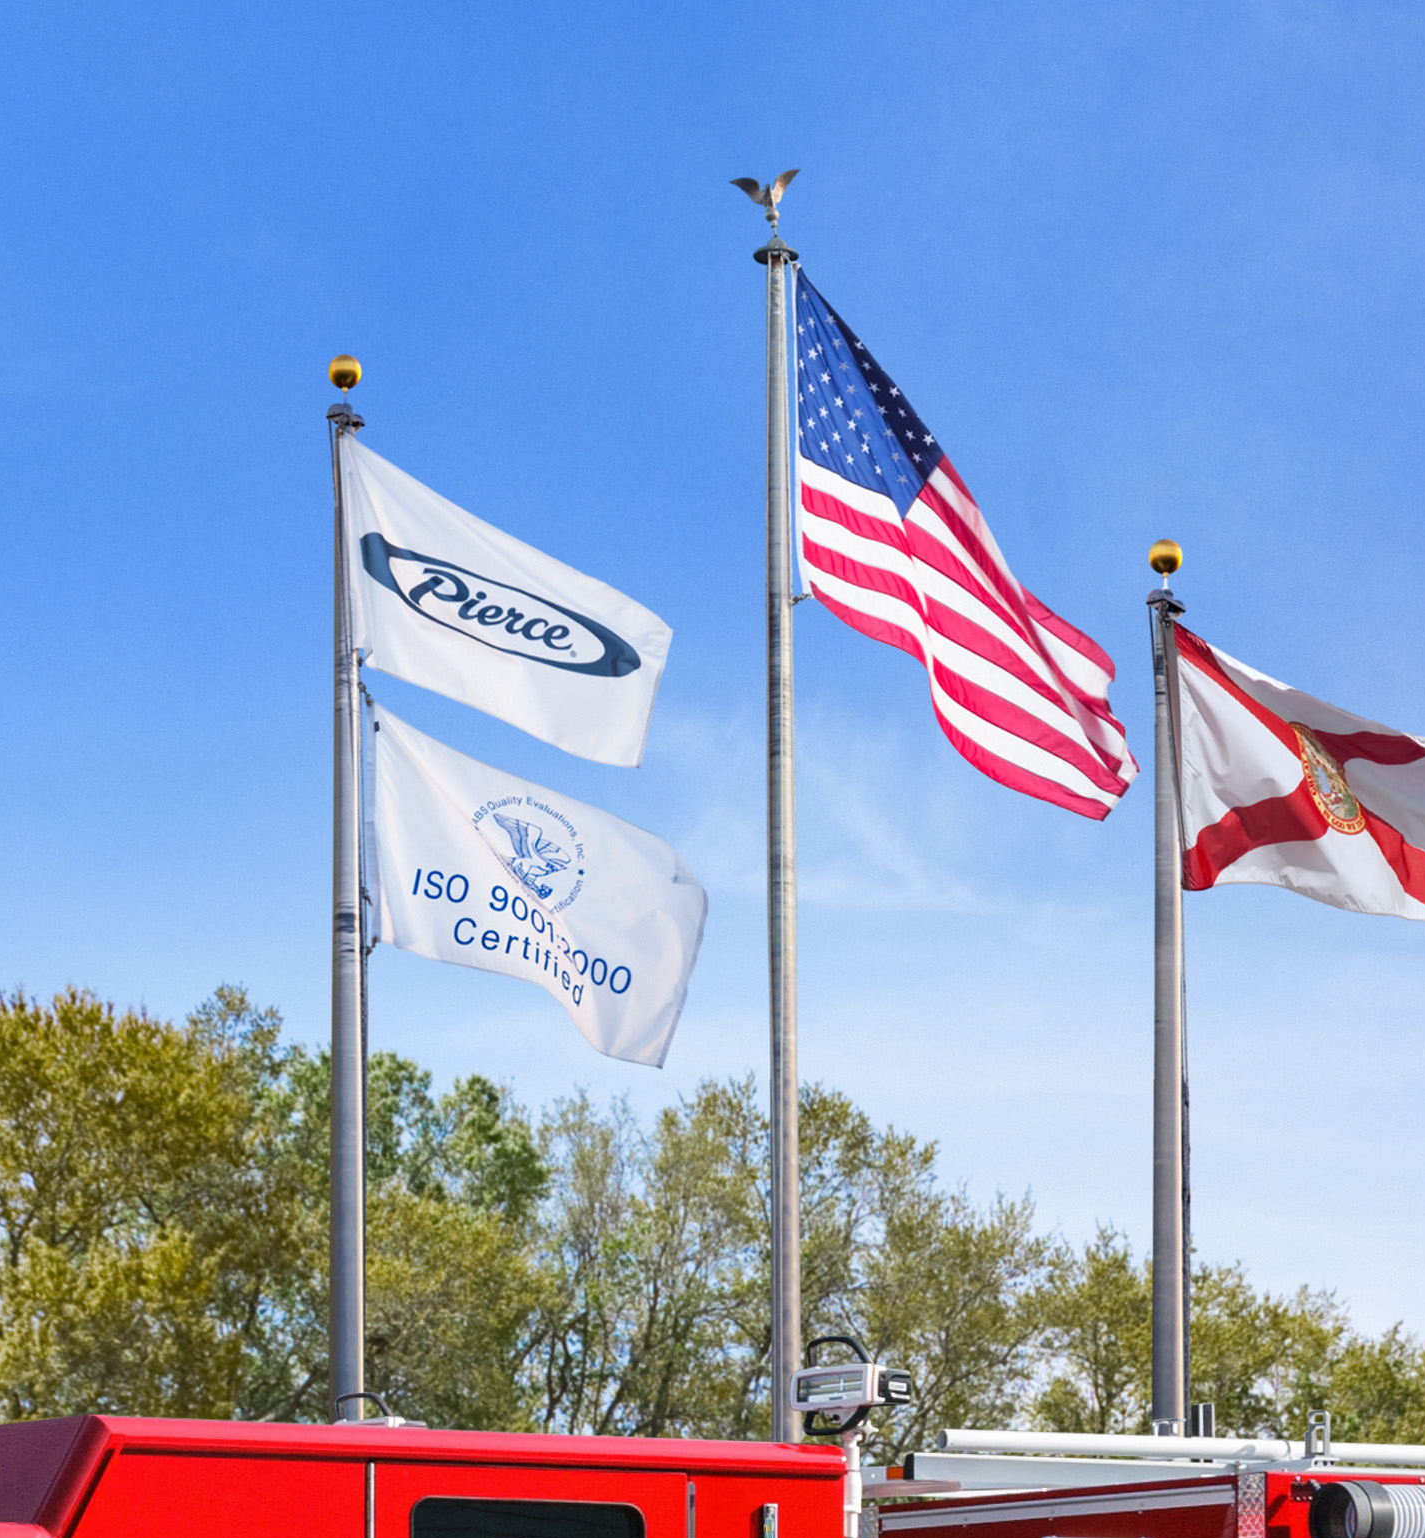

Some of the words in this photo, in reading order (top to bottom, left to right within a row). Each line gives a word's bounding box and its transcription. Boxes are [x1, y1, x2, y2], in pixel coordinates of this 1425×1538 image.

[409, 568, 574, 650] Pierce
[487, 796, 522, 810] Quality
[526, 796, 578, 841] Evaluations,
[575, 843, 585, 862] Inc.
[412, 868, 470, 904] ISO
[488, 885, 632, 995] 9001:2000
[453, 917, 585, 1007] Certified
